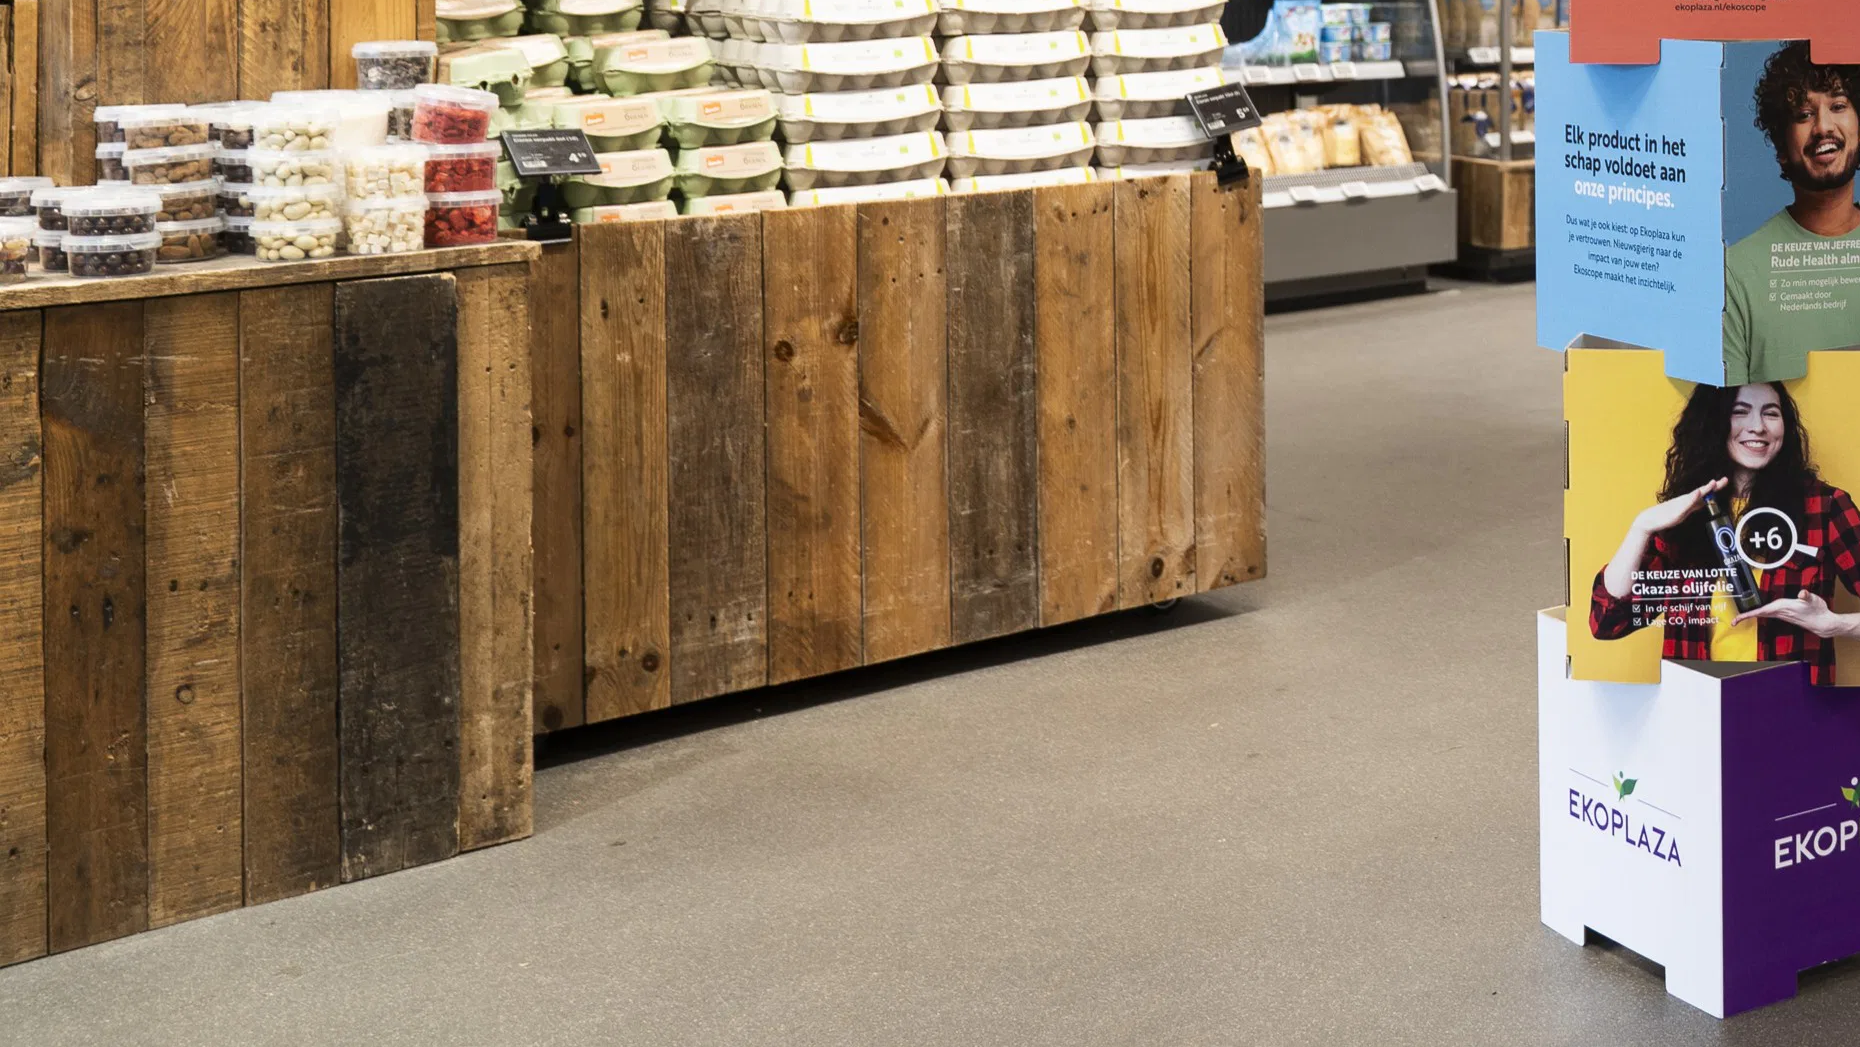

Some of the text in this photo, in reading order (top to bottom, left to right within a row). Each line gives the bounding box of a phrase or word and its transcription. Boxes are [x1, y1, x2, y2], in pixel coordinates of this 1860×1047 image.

[1675, 2, 1767, 13] ekoplaza.nl/ekoscope
[1565, 124, 1686, 157] Elk product in het
[1565, 151, 1686, 183] schap voldoet aan
[1575, 179, 1675, 210] onze principes.
[1566, 214, 1578, 226] Dus
[1579, 218, 1590, 228] wat
[1590, 218, 1597, 230] je
[1598, 220, 1610, 231] ook
[1630, 227, 1639, 237] op
[1640, 226, 1670, 242] Ekoplaza
[1671, 231, 1685, 243] kun
[1771, 243, 1783, 253] DE
[1785, 242, 1812, 252] KEUZE
[1813, 241, 1829, 250] VAN
[1771, 255, 1800, 268] Rude
[1802, 253, 1838, 267] Health
[1573, 264, 1676, 293] Ekoscope maakt het inzichtelijk.
[1781, 279, 1790, 288] Zo
[1792, 279, 1807, 287] min
[1808, 277, 1838, 288] mogelijk
[1750, 526, 1783, 550] +6
[1631, 568, 1737, 580] DE KEUZE VAN LOTTE
[1631, 579, 1735, 596] Gkazas olijfolie
[1569, 788, 1682, 867] EKOPLAZA
